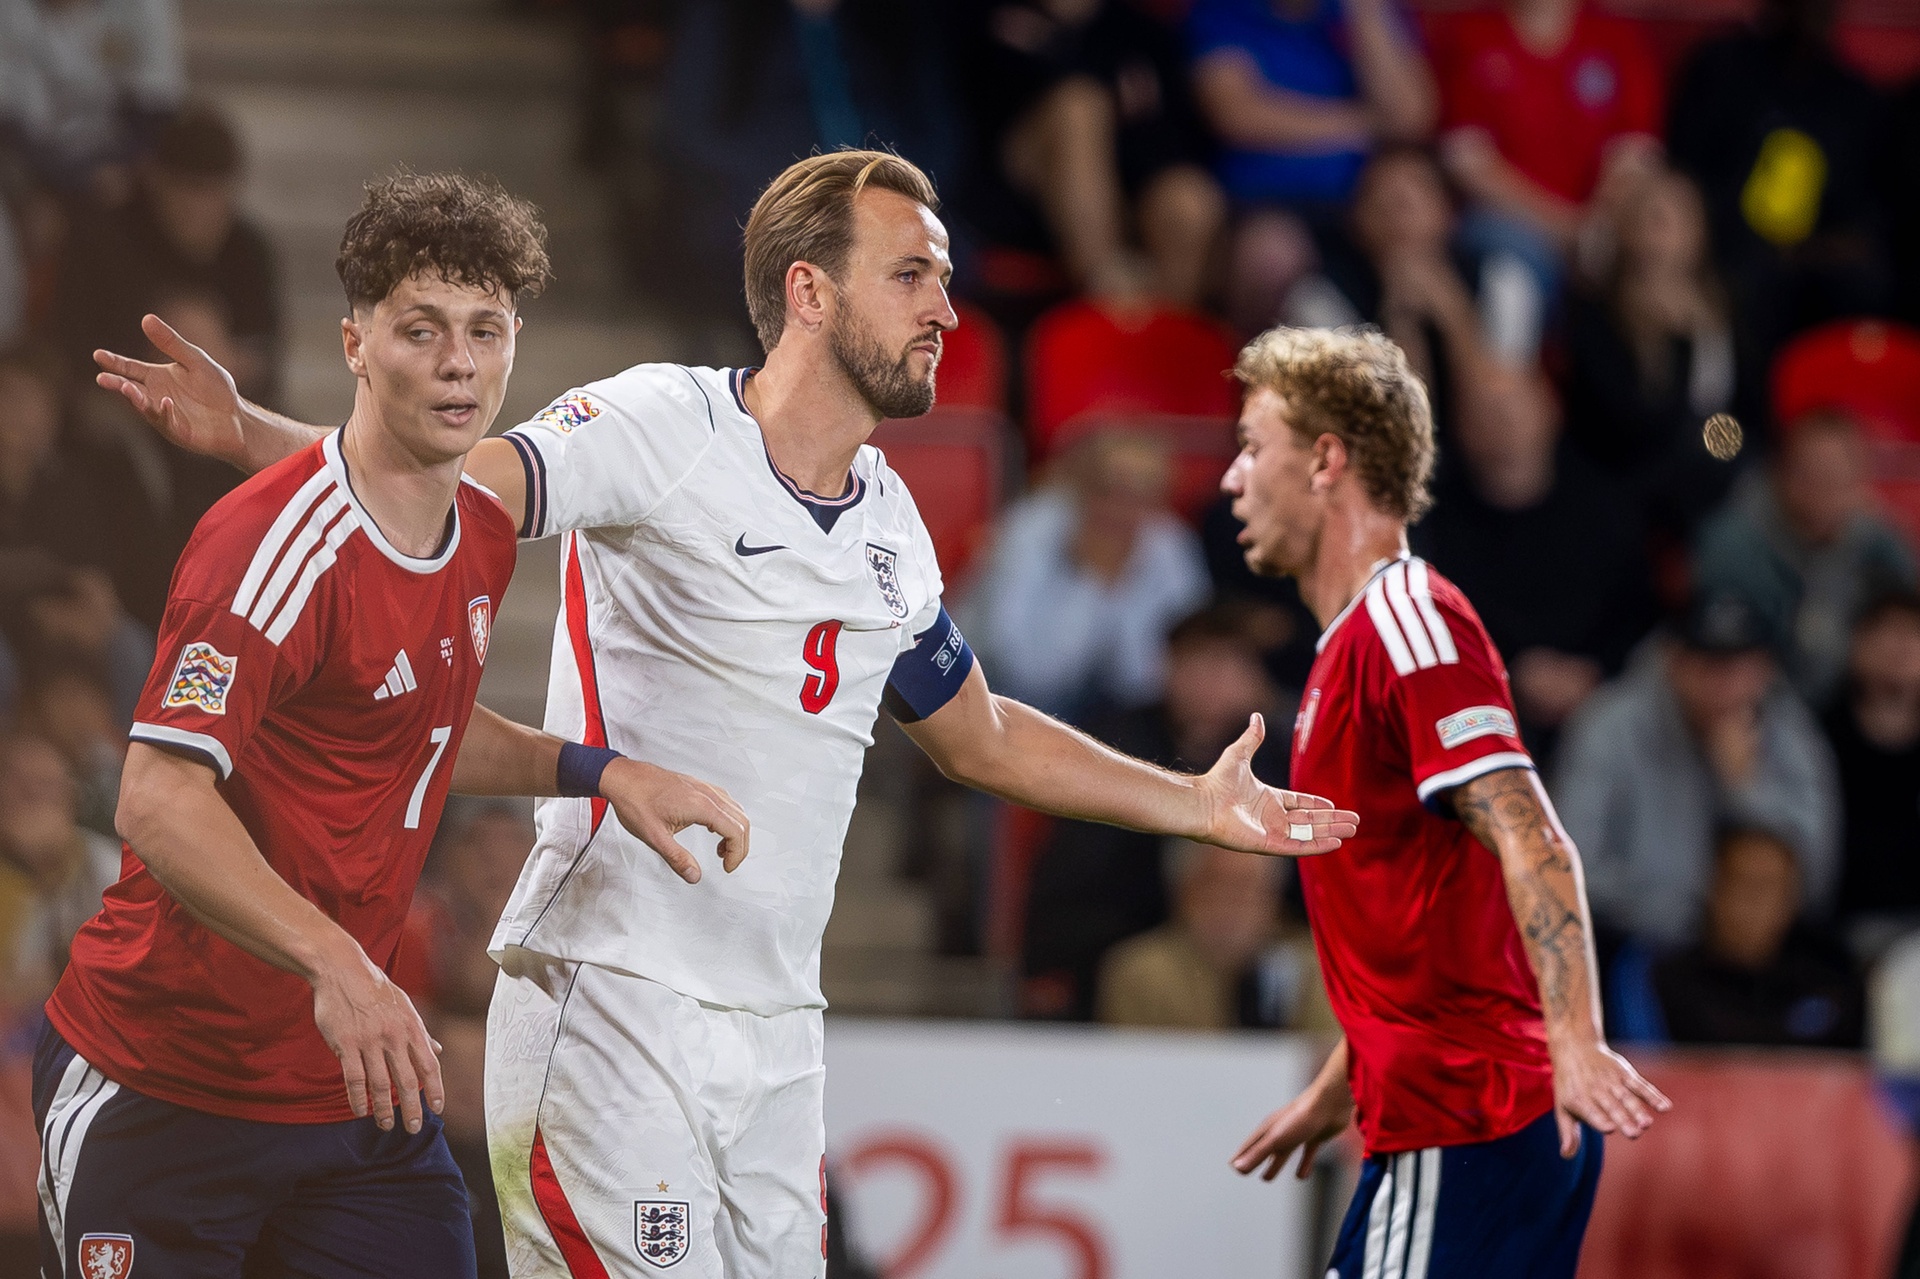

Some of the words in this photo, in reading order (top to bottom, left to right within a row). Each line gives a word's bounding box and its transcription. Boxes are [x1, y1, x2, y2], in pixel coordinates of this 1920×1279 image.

[799, 619, 843, 714] 9
[949, 623, 961, 651] RE
[404, 725, 452, 829] 7
[843, 1132, 1115, 1279] 25
